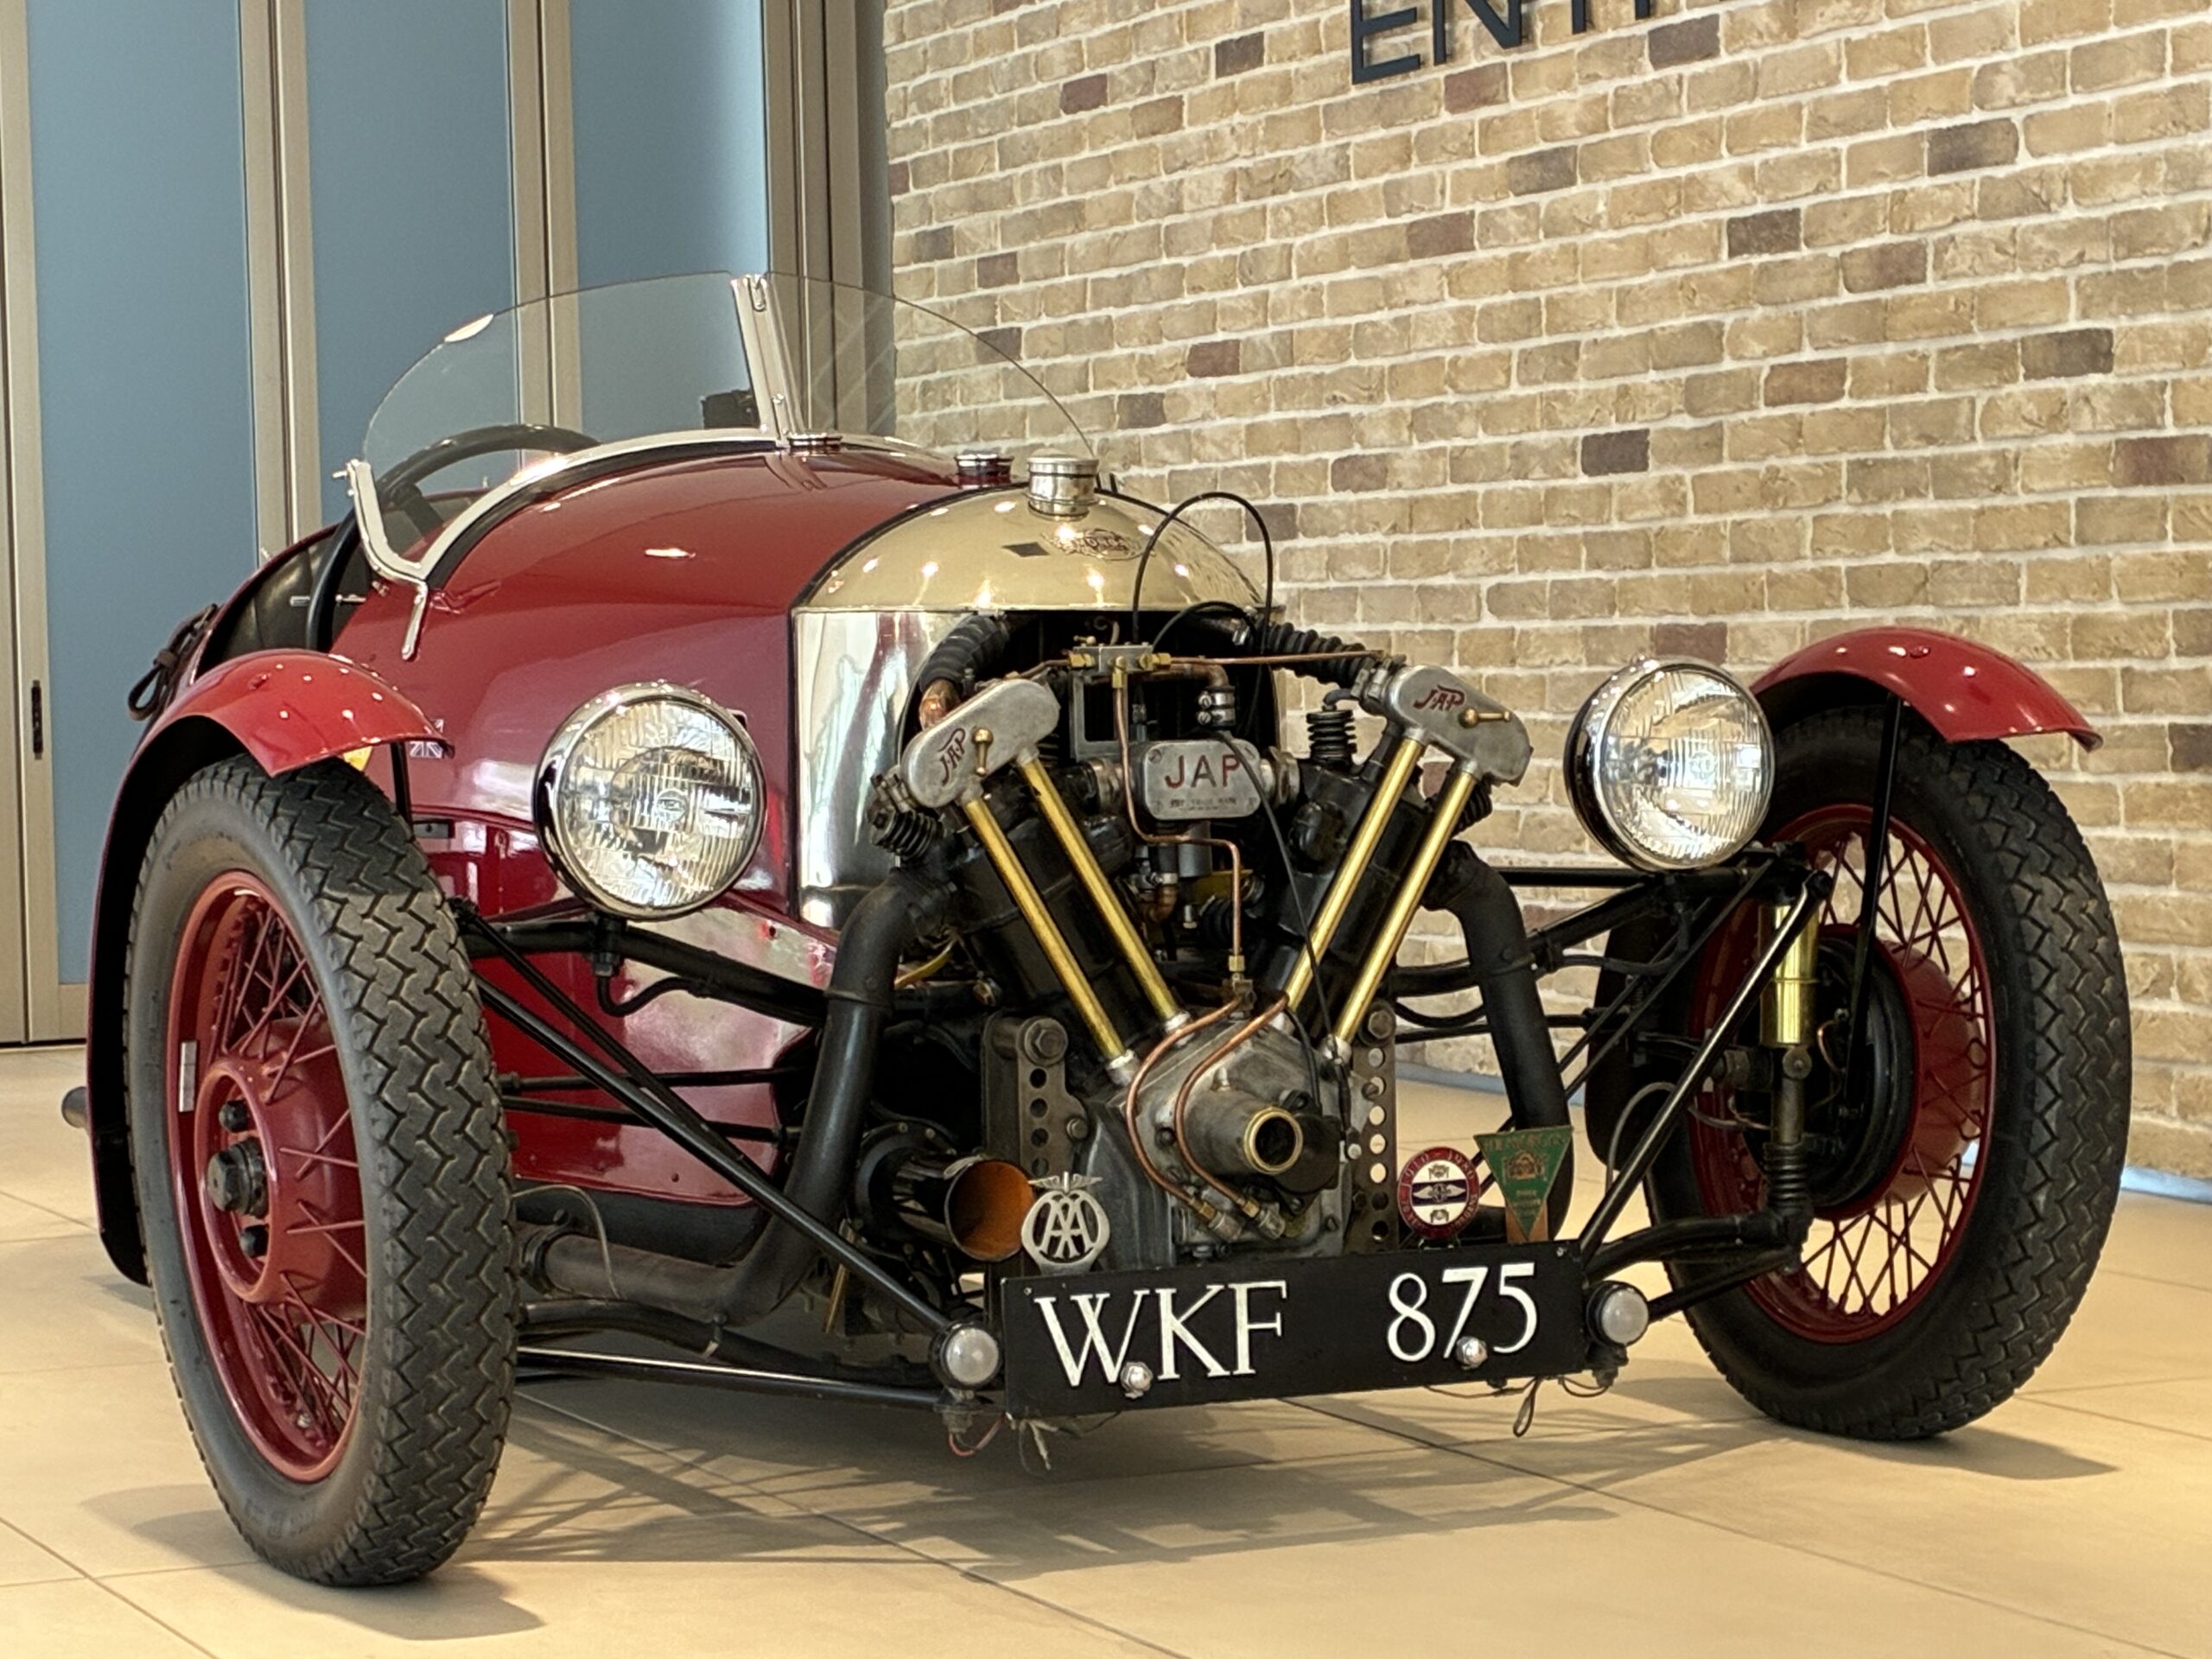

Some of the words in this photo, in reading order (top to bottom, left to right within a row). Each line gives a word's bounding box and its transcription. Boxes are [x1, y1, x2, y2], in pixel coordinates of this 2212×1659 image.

[1164, 746, 1240, 789] JAP
[1039, 1196, 1096, 1259] AA
[1033, 1281, 1287, 1386] WKF
[1387, 1262, 1537, 1362] 875
